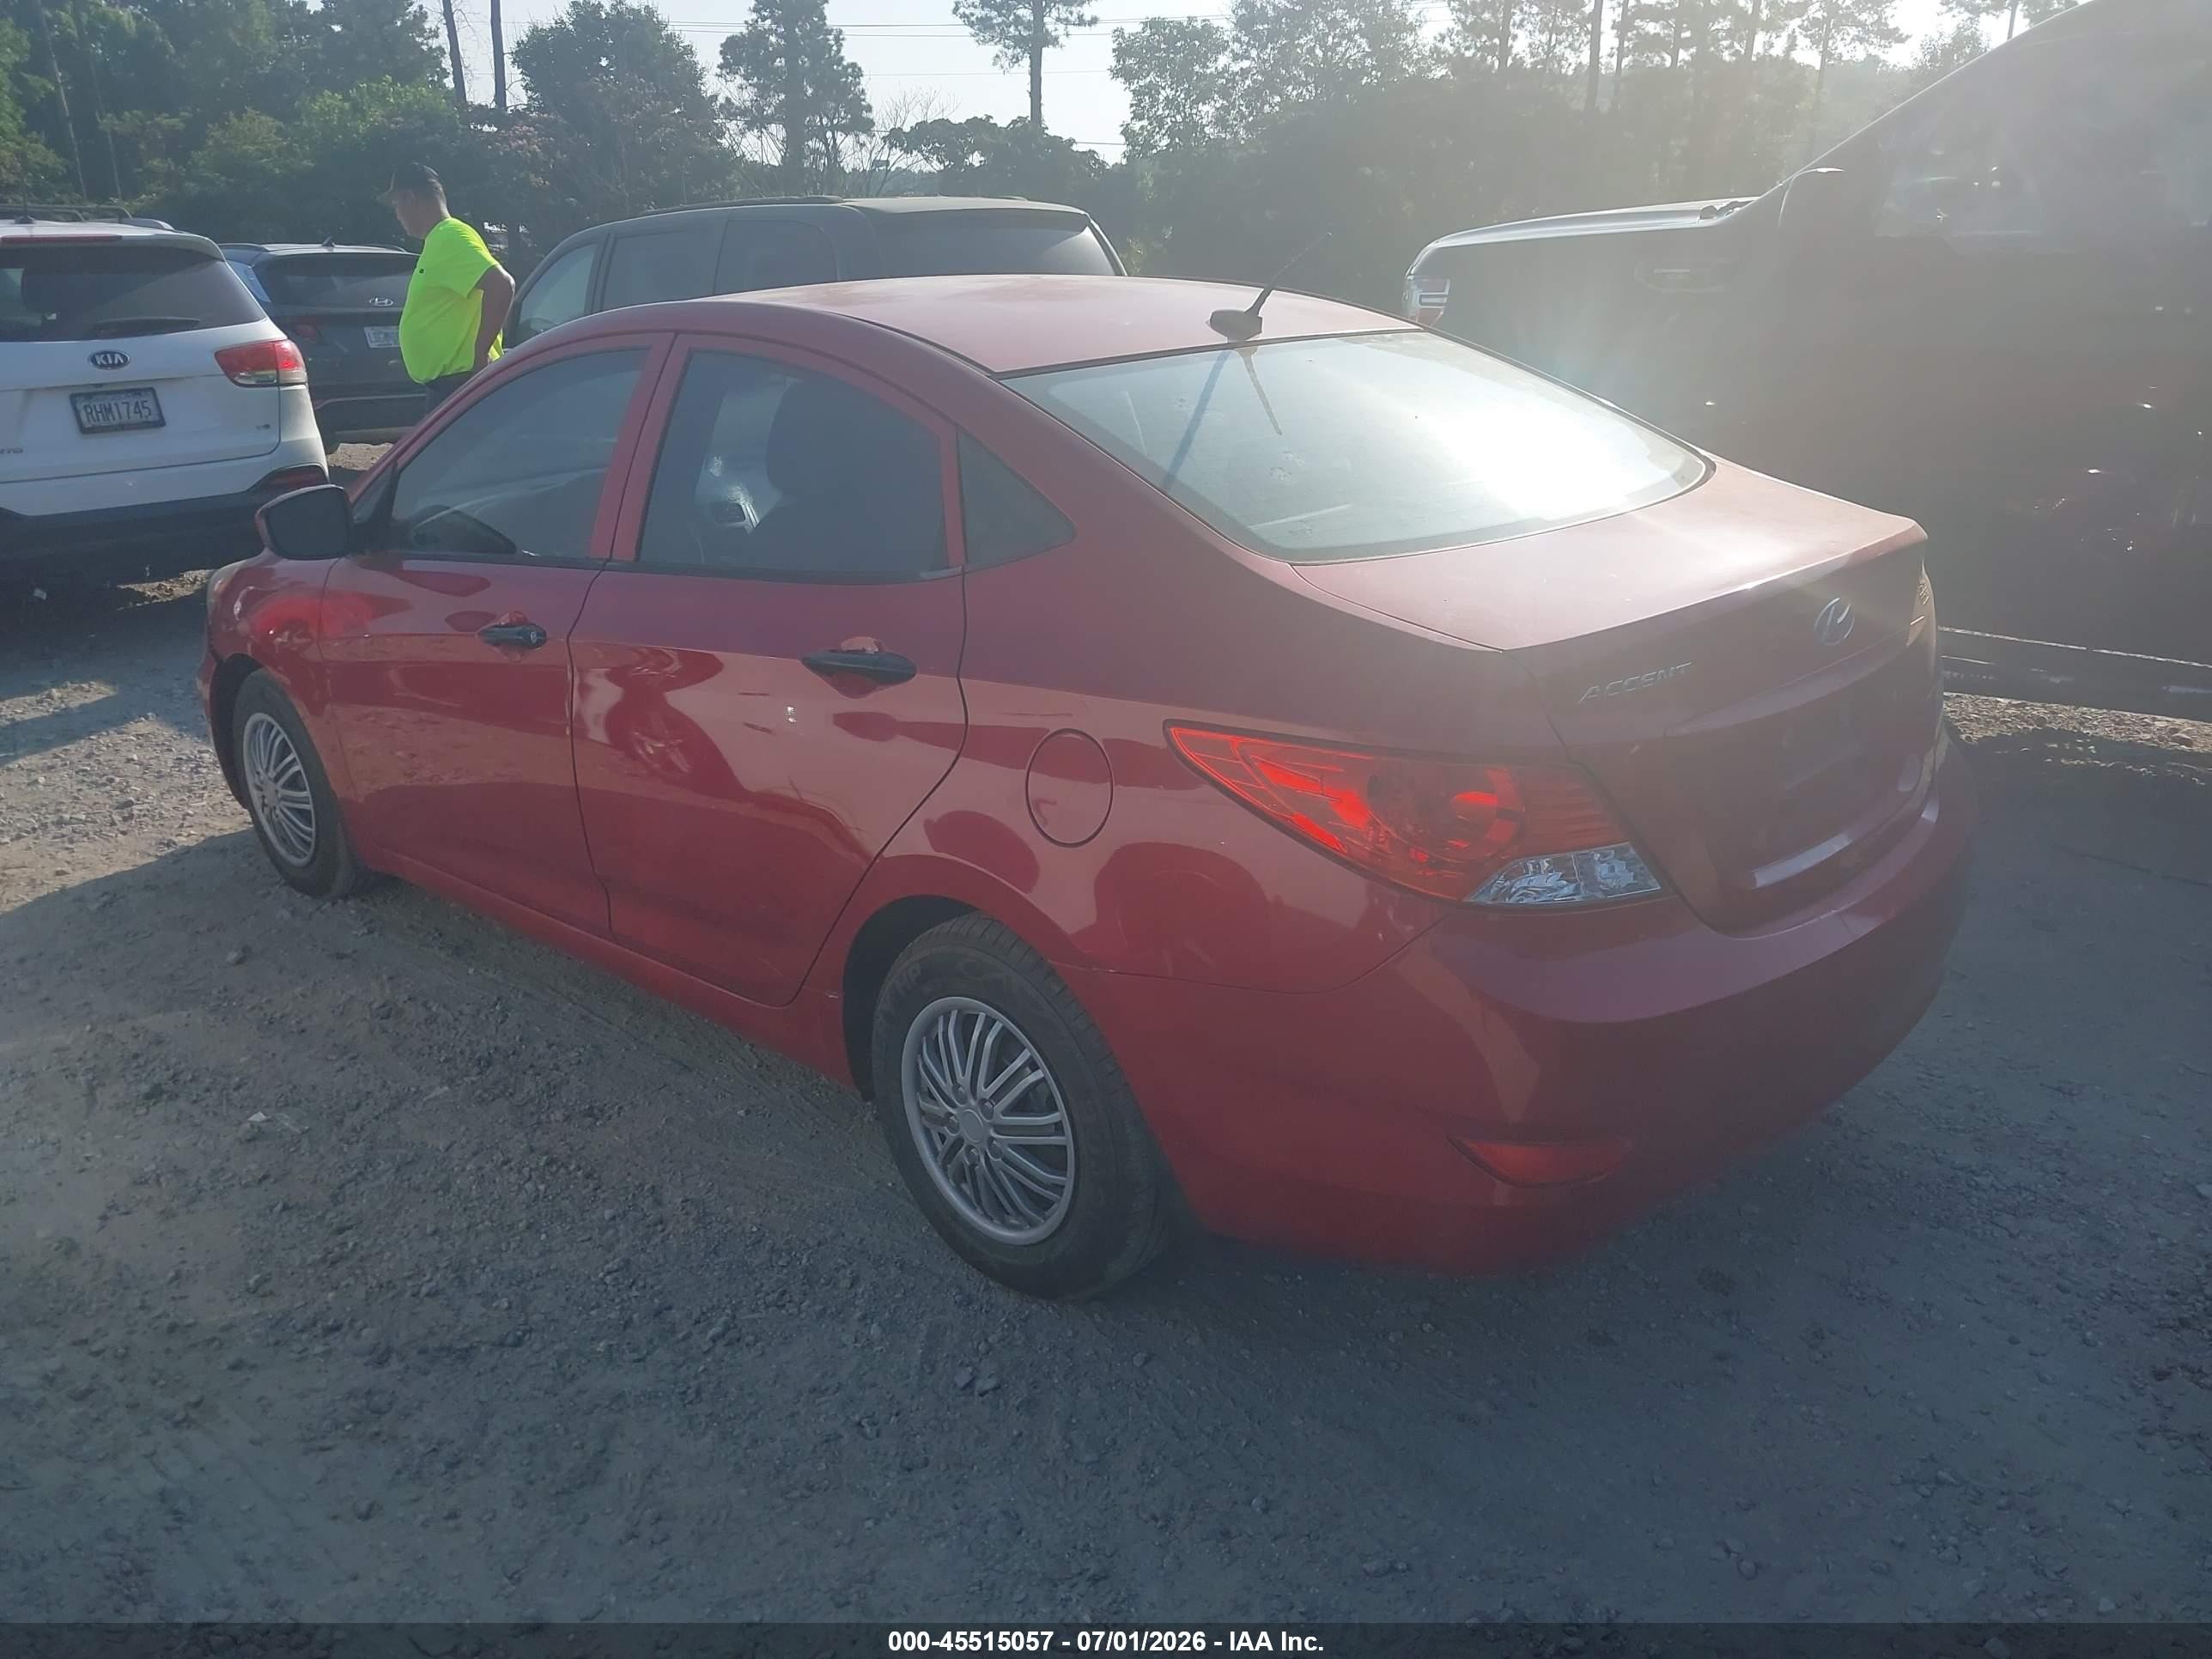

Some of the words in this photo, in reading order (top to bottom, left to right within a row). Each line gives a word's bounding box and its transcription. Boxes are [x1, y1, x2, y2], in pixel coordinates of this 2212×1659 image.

[96, 353, 125, 365] KIA
[82, 400, 152, 424] RHM1745
[1577, 661, 1692, 704] ACCENT
